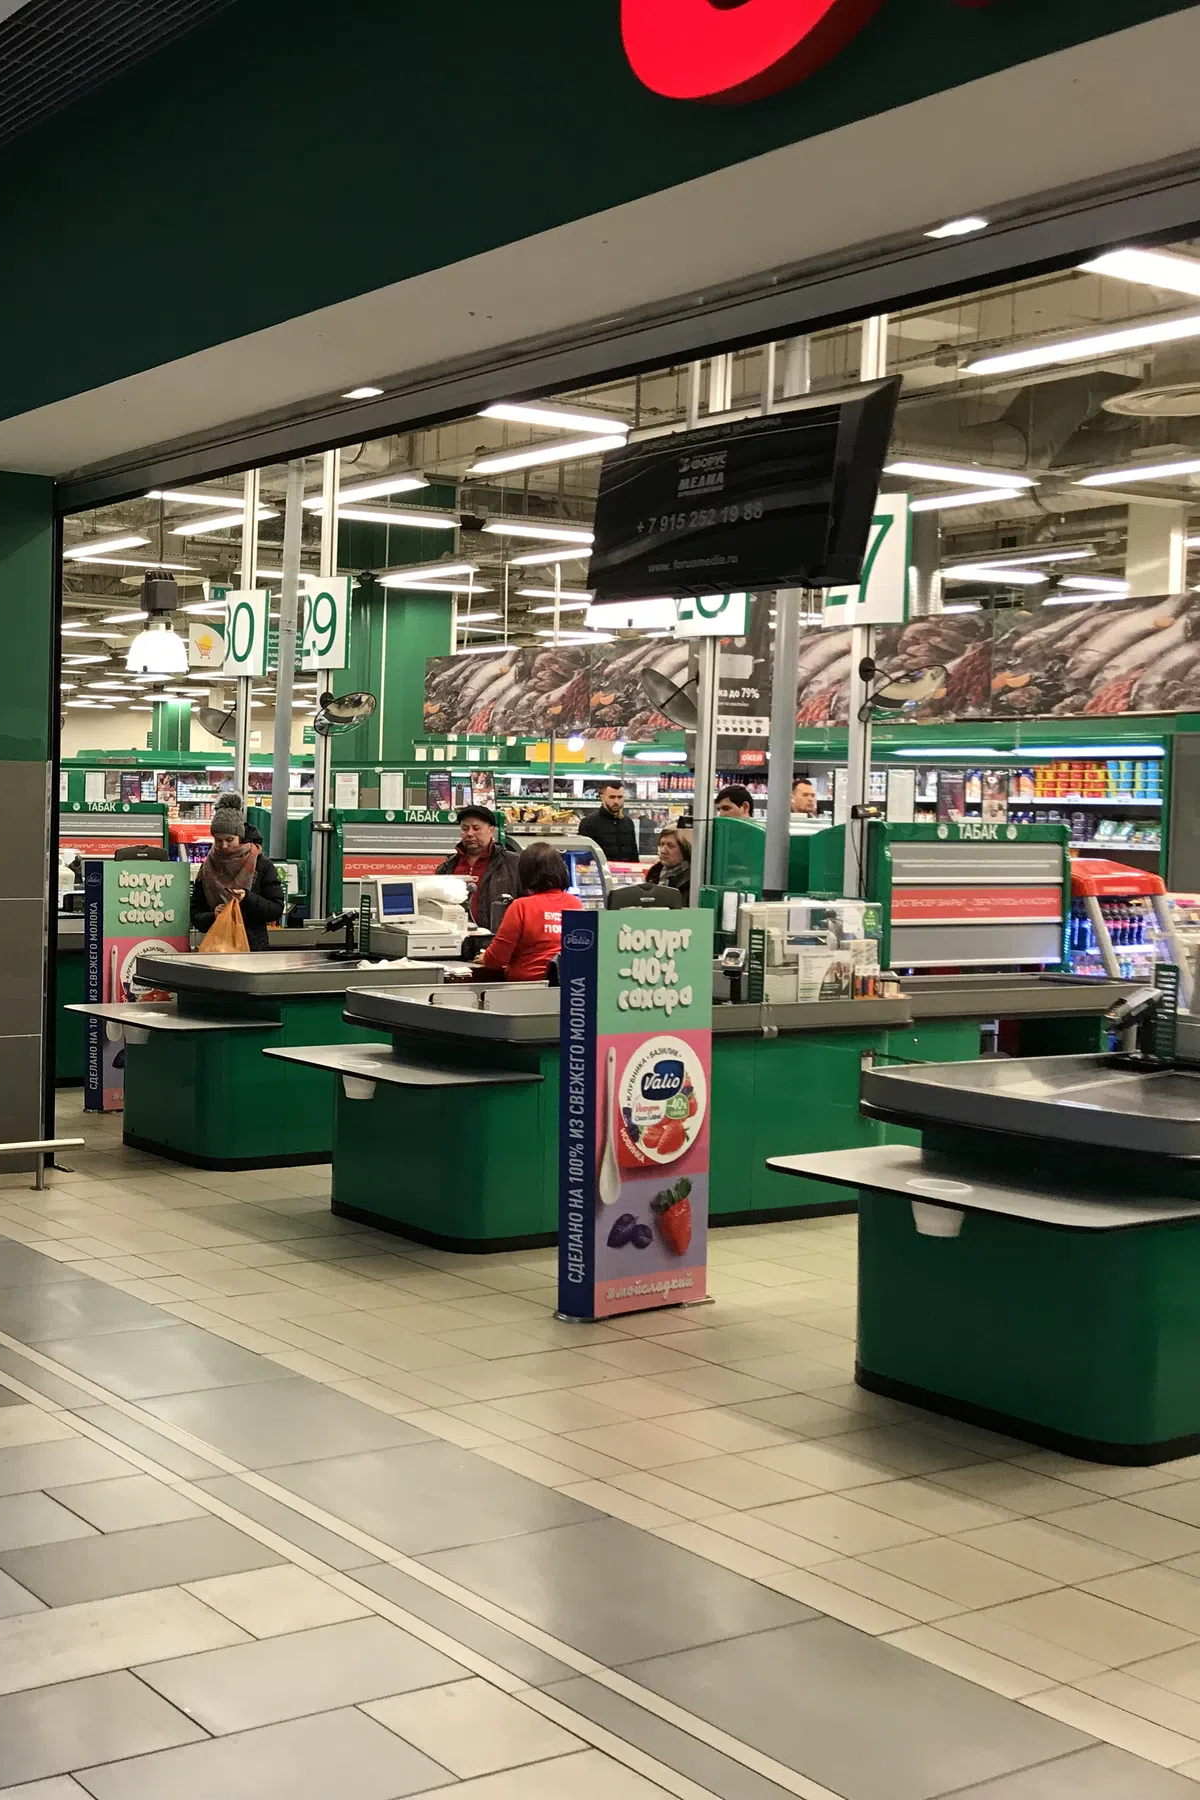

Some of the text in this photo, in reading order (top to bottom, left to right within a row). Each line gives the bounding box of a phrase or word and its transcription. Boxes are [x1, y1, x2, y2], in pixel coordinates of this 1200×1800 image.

[741, 687, 760, 698] 79%
[87, 802, 116, 811] ТАБАК
[404, 810, 440, 822] ТАБАК
[957, 824, 998, 839] ТАБАК
[119, 870, 174, 892] йогурт
[120, 891, 163, 908] -40%
[90, 902, 98, 942] МОЛОКА
[120, 909, 174, 928] сахара
[618, 924, 692, 958] йогурт
[90, 944, 98, 987] СВЕЖЕГО
[619, 957, 679, 985] -40%
[90, 988, 98, 1001] ИЗ
[618, 985, 692, 1016] сахара
[90, 1031, 98, 1044] НА
[89, 1046, 98, 1090] СДЕЛАНО
[644, 1073, 680, 1091] Valio
[568, 977, 586, 1284] СДЕЛАНО НА 100% ИЗ СВЕЖЕГО МОЛОКА
